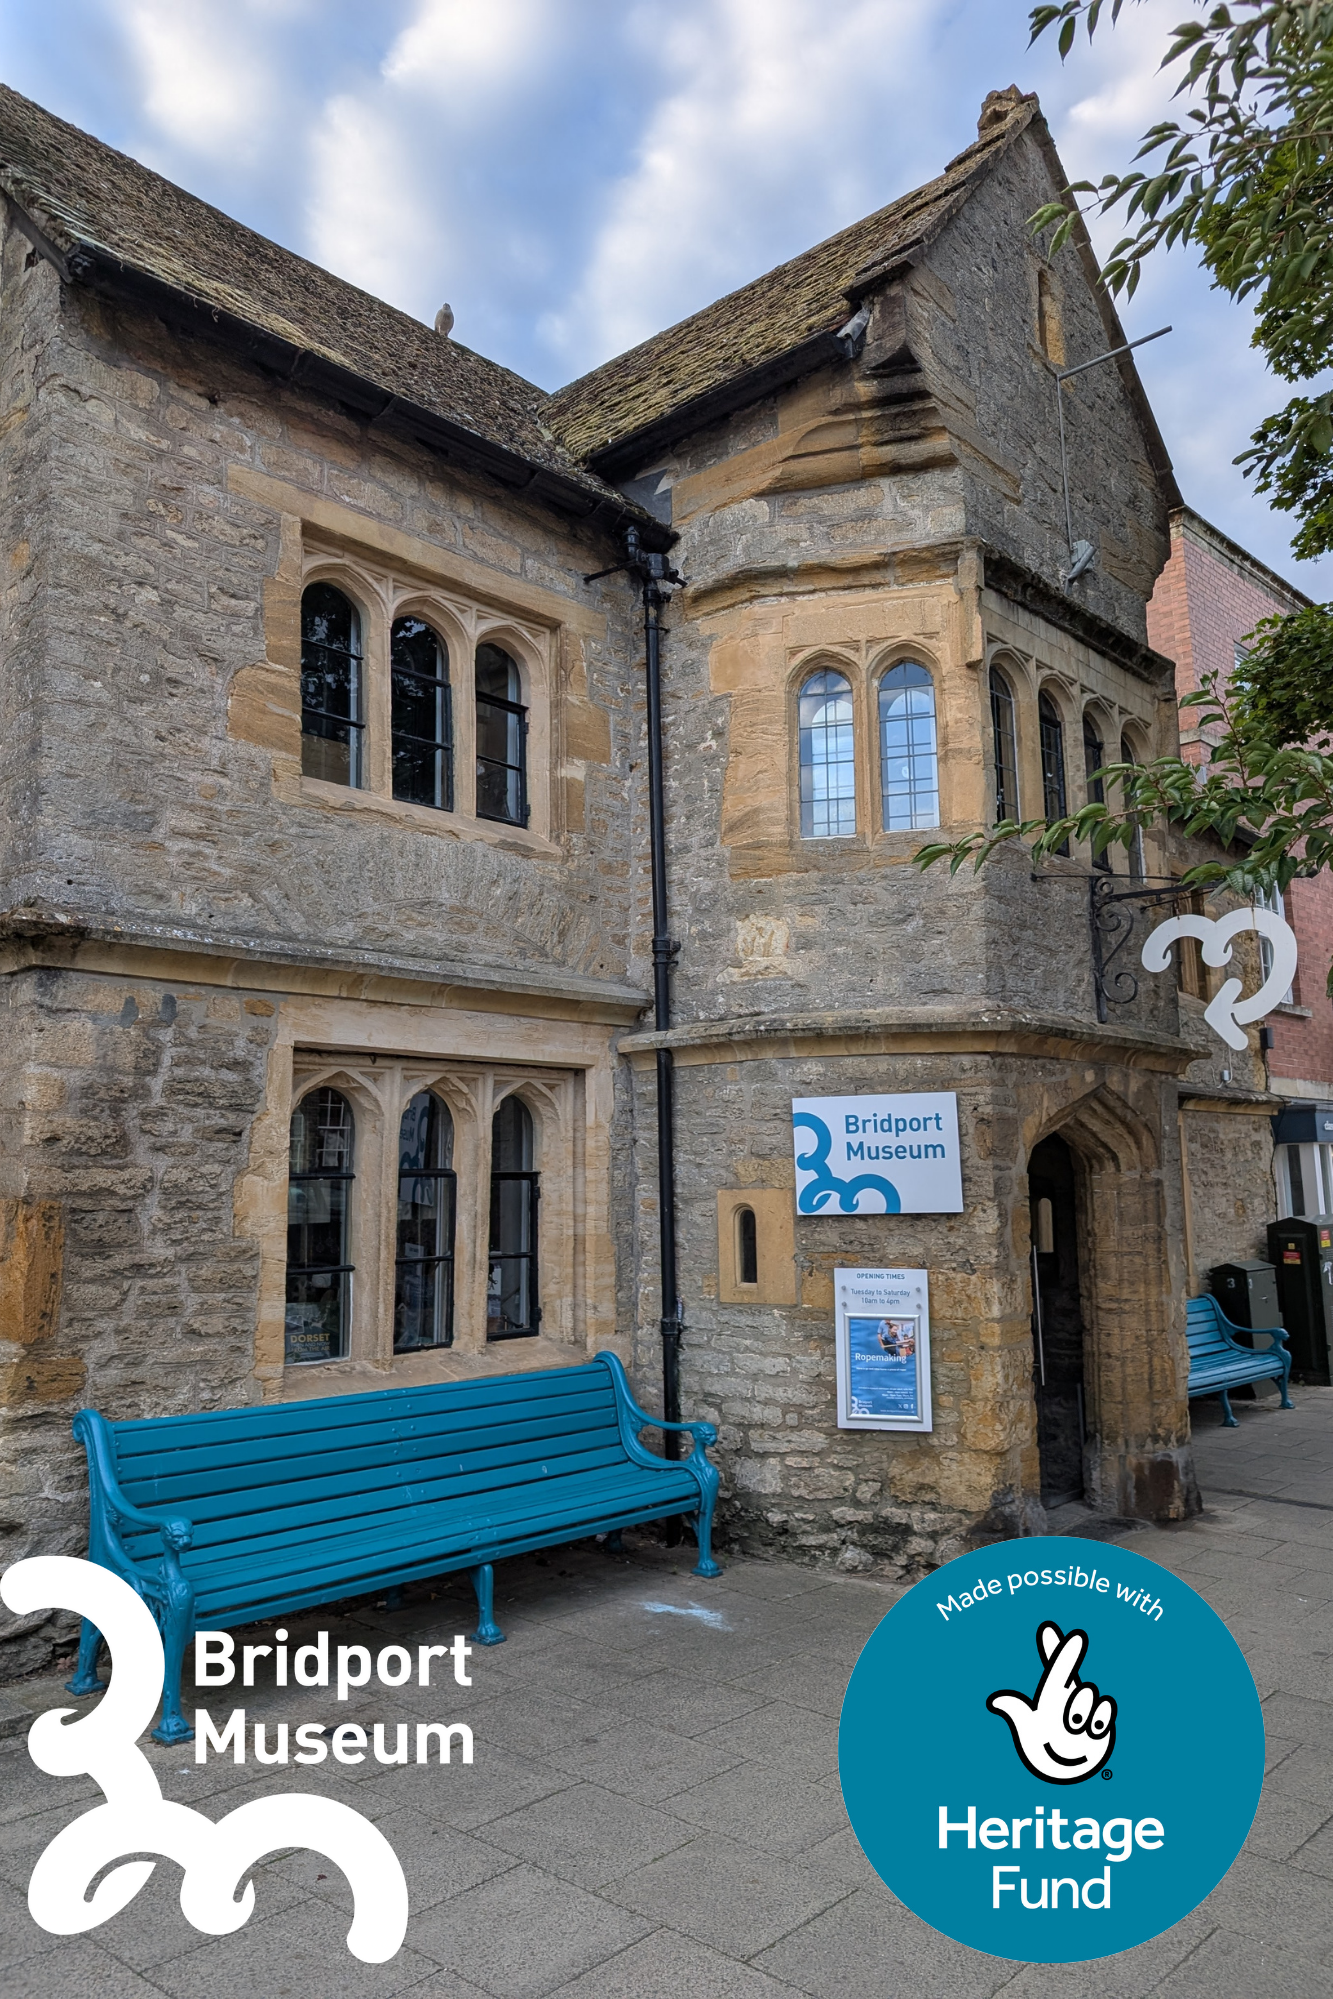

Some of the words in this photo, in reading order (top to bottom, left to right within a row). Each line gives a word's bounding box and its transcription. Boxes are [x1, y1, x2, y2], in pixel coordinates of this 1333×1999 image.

[845, 1113, 943, 1137] Bridport
[846, 1141, 946, 1161] Museum
[1226, 1278, 1236, 1288] 3
[851, 1288, 875, 1297] Tuesday
[883, 1289, 911, 1297] Saturday
[886, 1298, 900, 1306] 4pm
[290, 1334, 330, 1342] DORSET
[855, 1352, 907, 1364] Ropemaking
